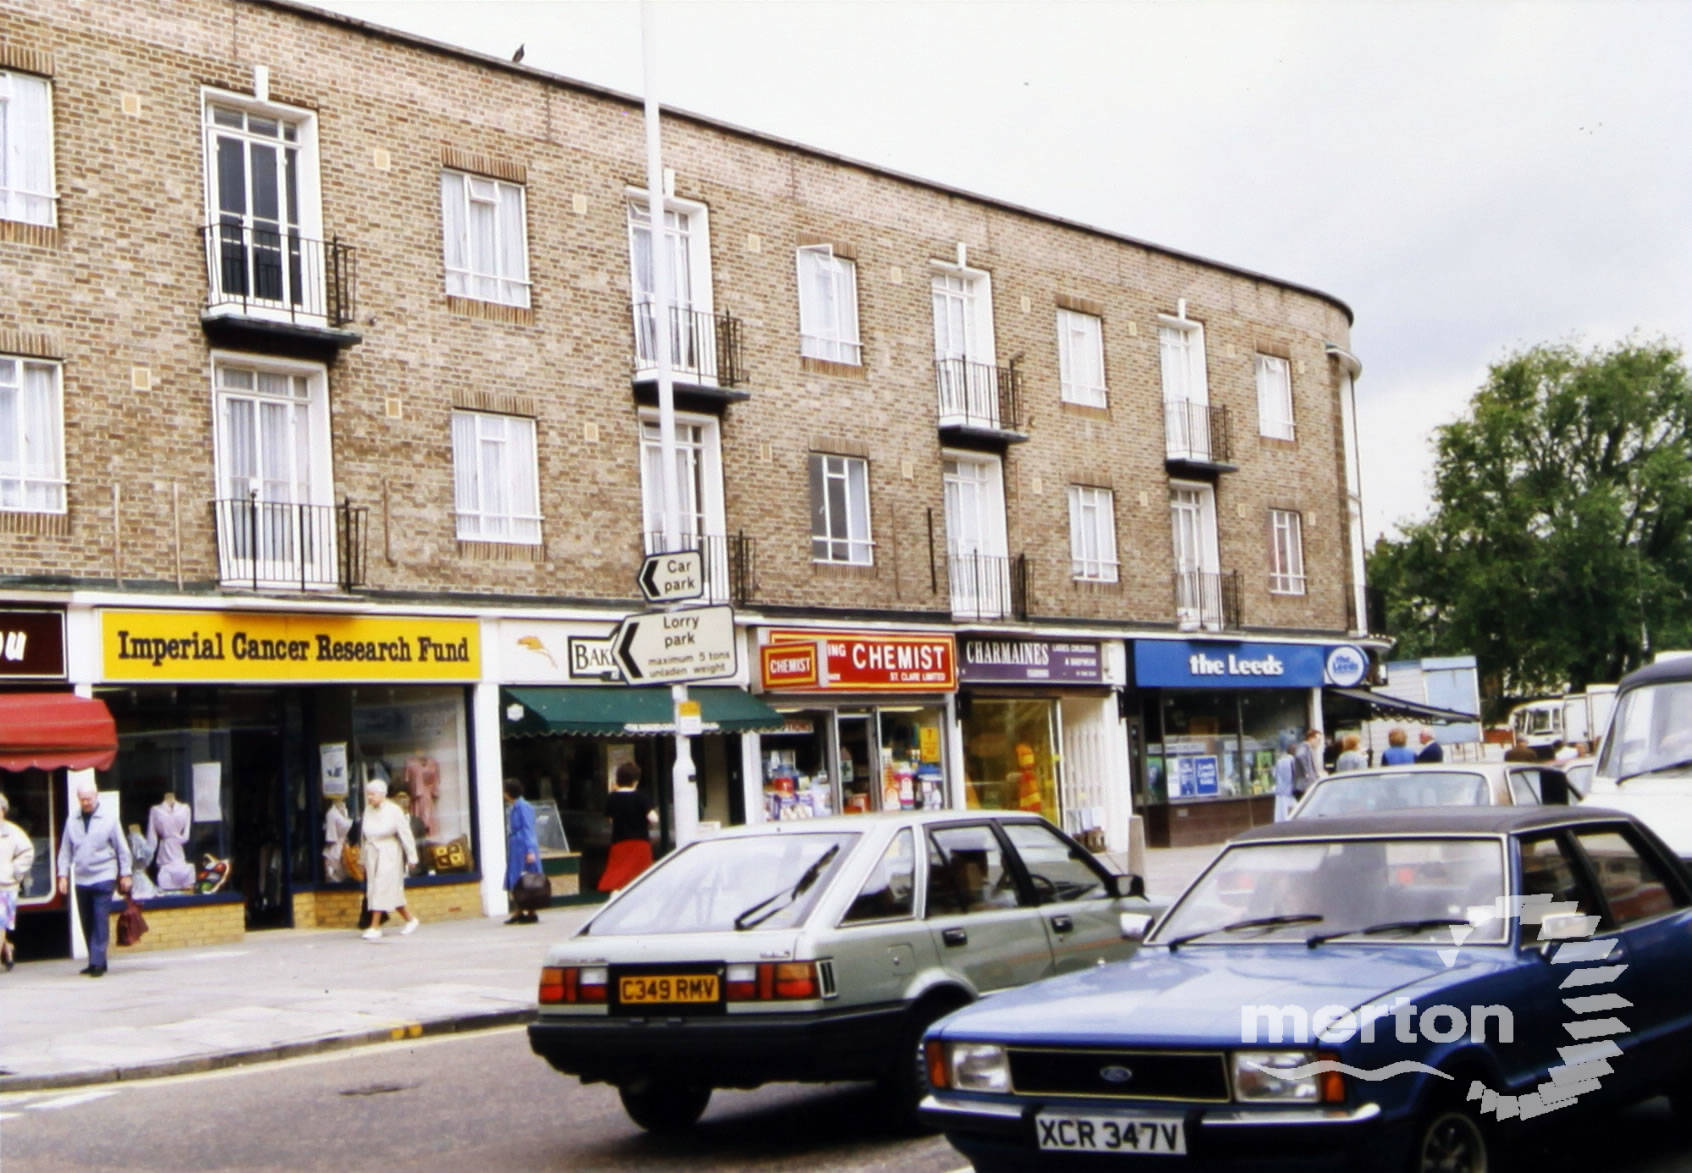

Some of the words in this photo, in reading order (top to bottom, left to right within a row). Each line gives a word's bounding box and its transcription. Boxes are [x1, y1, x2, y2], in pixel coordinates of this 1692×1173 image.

[667, 559, 691, 574] Car
[664, 577, 696, 594] park
[663, 616, 700, 631] Lorry
[117, 630, 225, 667] Imperial
[232, 632, 310, 661] Cancer
[315, 634, 412, 662] Research
[418, 636, 470, 662] Fund
[664, 632, 696, 649] park
[648, 654, 694, 665] maximum
[699, 651, 705, 662] 5
[709, 650, 730, 661] tons
[852, 643, 944, 670] CHEMIST
[966, 641, 1050, 666] CHARMAINES
[649, 667, 688, 678] unladen
[693, 663, 726, 675] weight
[769, 657, 811, 675] CHEMIST
[1189, 652, 1225, 675] the
[1228, 653, 1284, 676] Leeds
[621, 979, 671, 1000] C349
[676, 978, 716, 998] RMV
[1039, 1119, 1097, 1148] XCR
[1102, 1121, 1178, 1151] 347V
